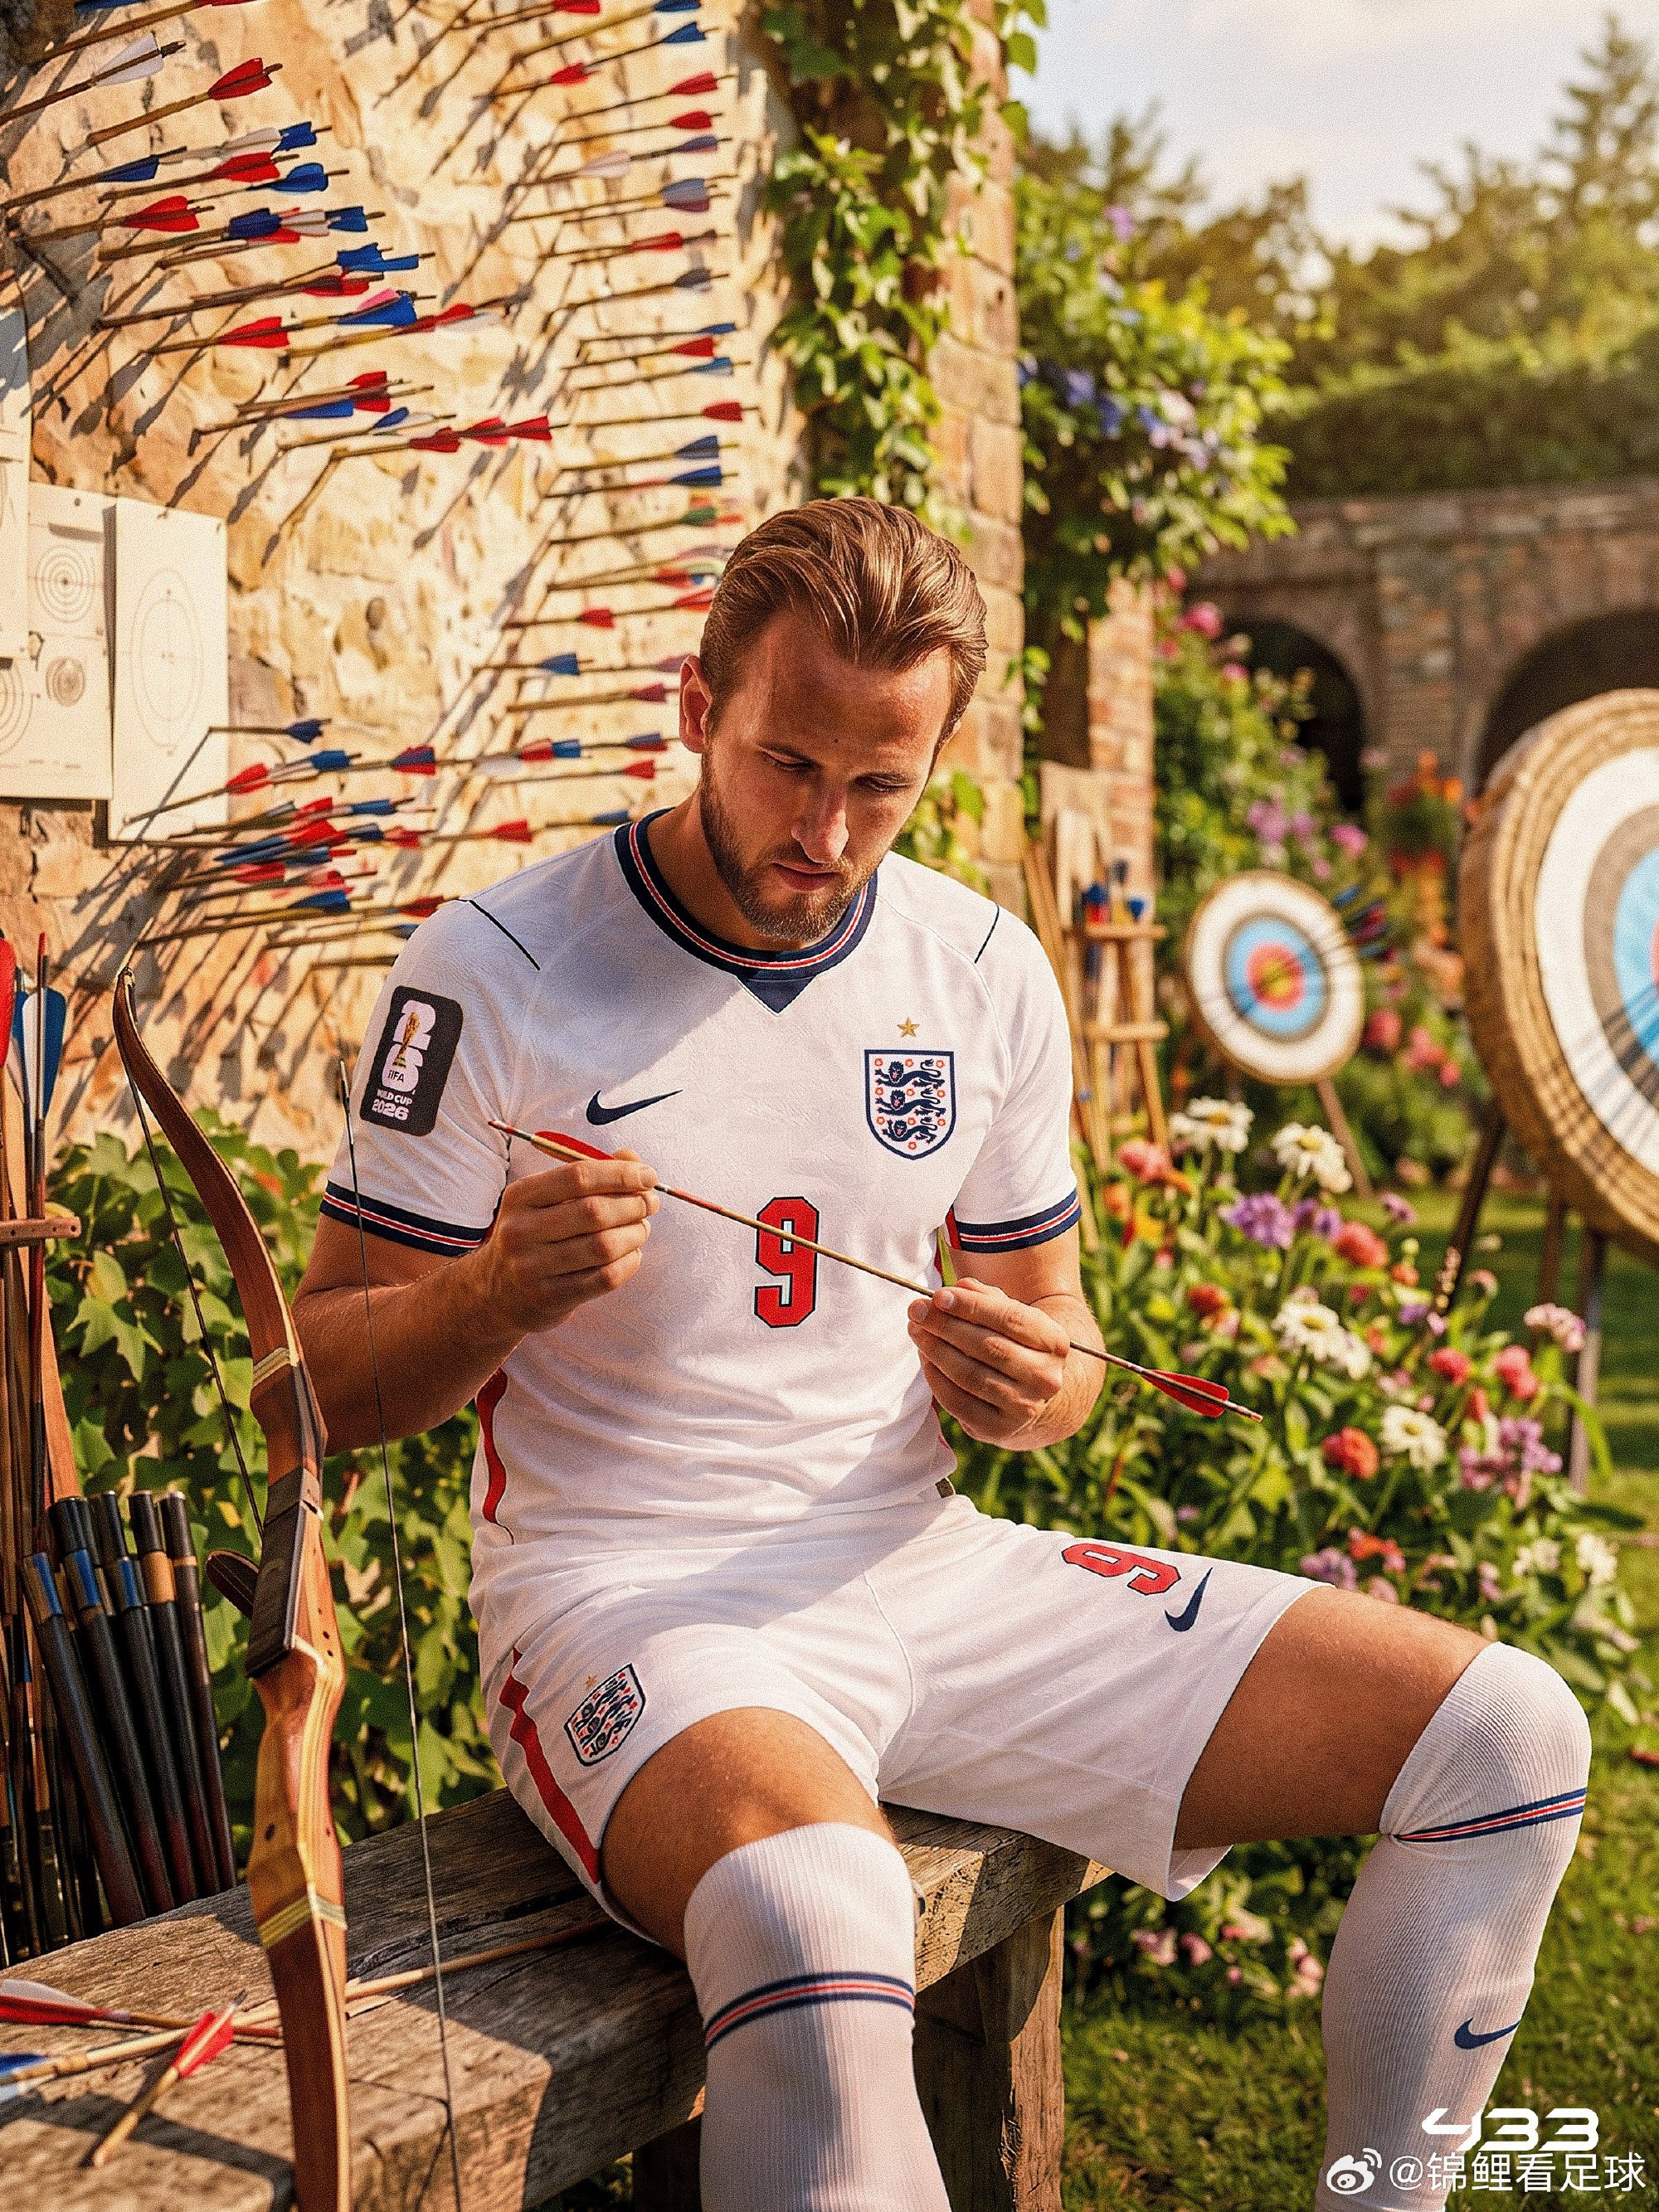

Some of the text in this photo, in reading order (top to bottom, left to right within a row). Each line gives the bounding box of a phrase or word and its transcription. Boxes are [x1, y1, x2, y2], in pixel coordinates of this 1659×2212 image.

[372, 1098, 410, 1121] 2026
[394, 1094, 413, 1106] CUP
[754, 1196, 820, 1328] 9
[1061, 1543, 1181, 1596] 9
